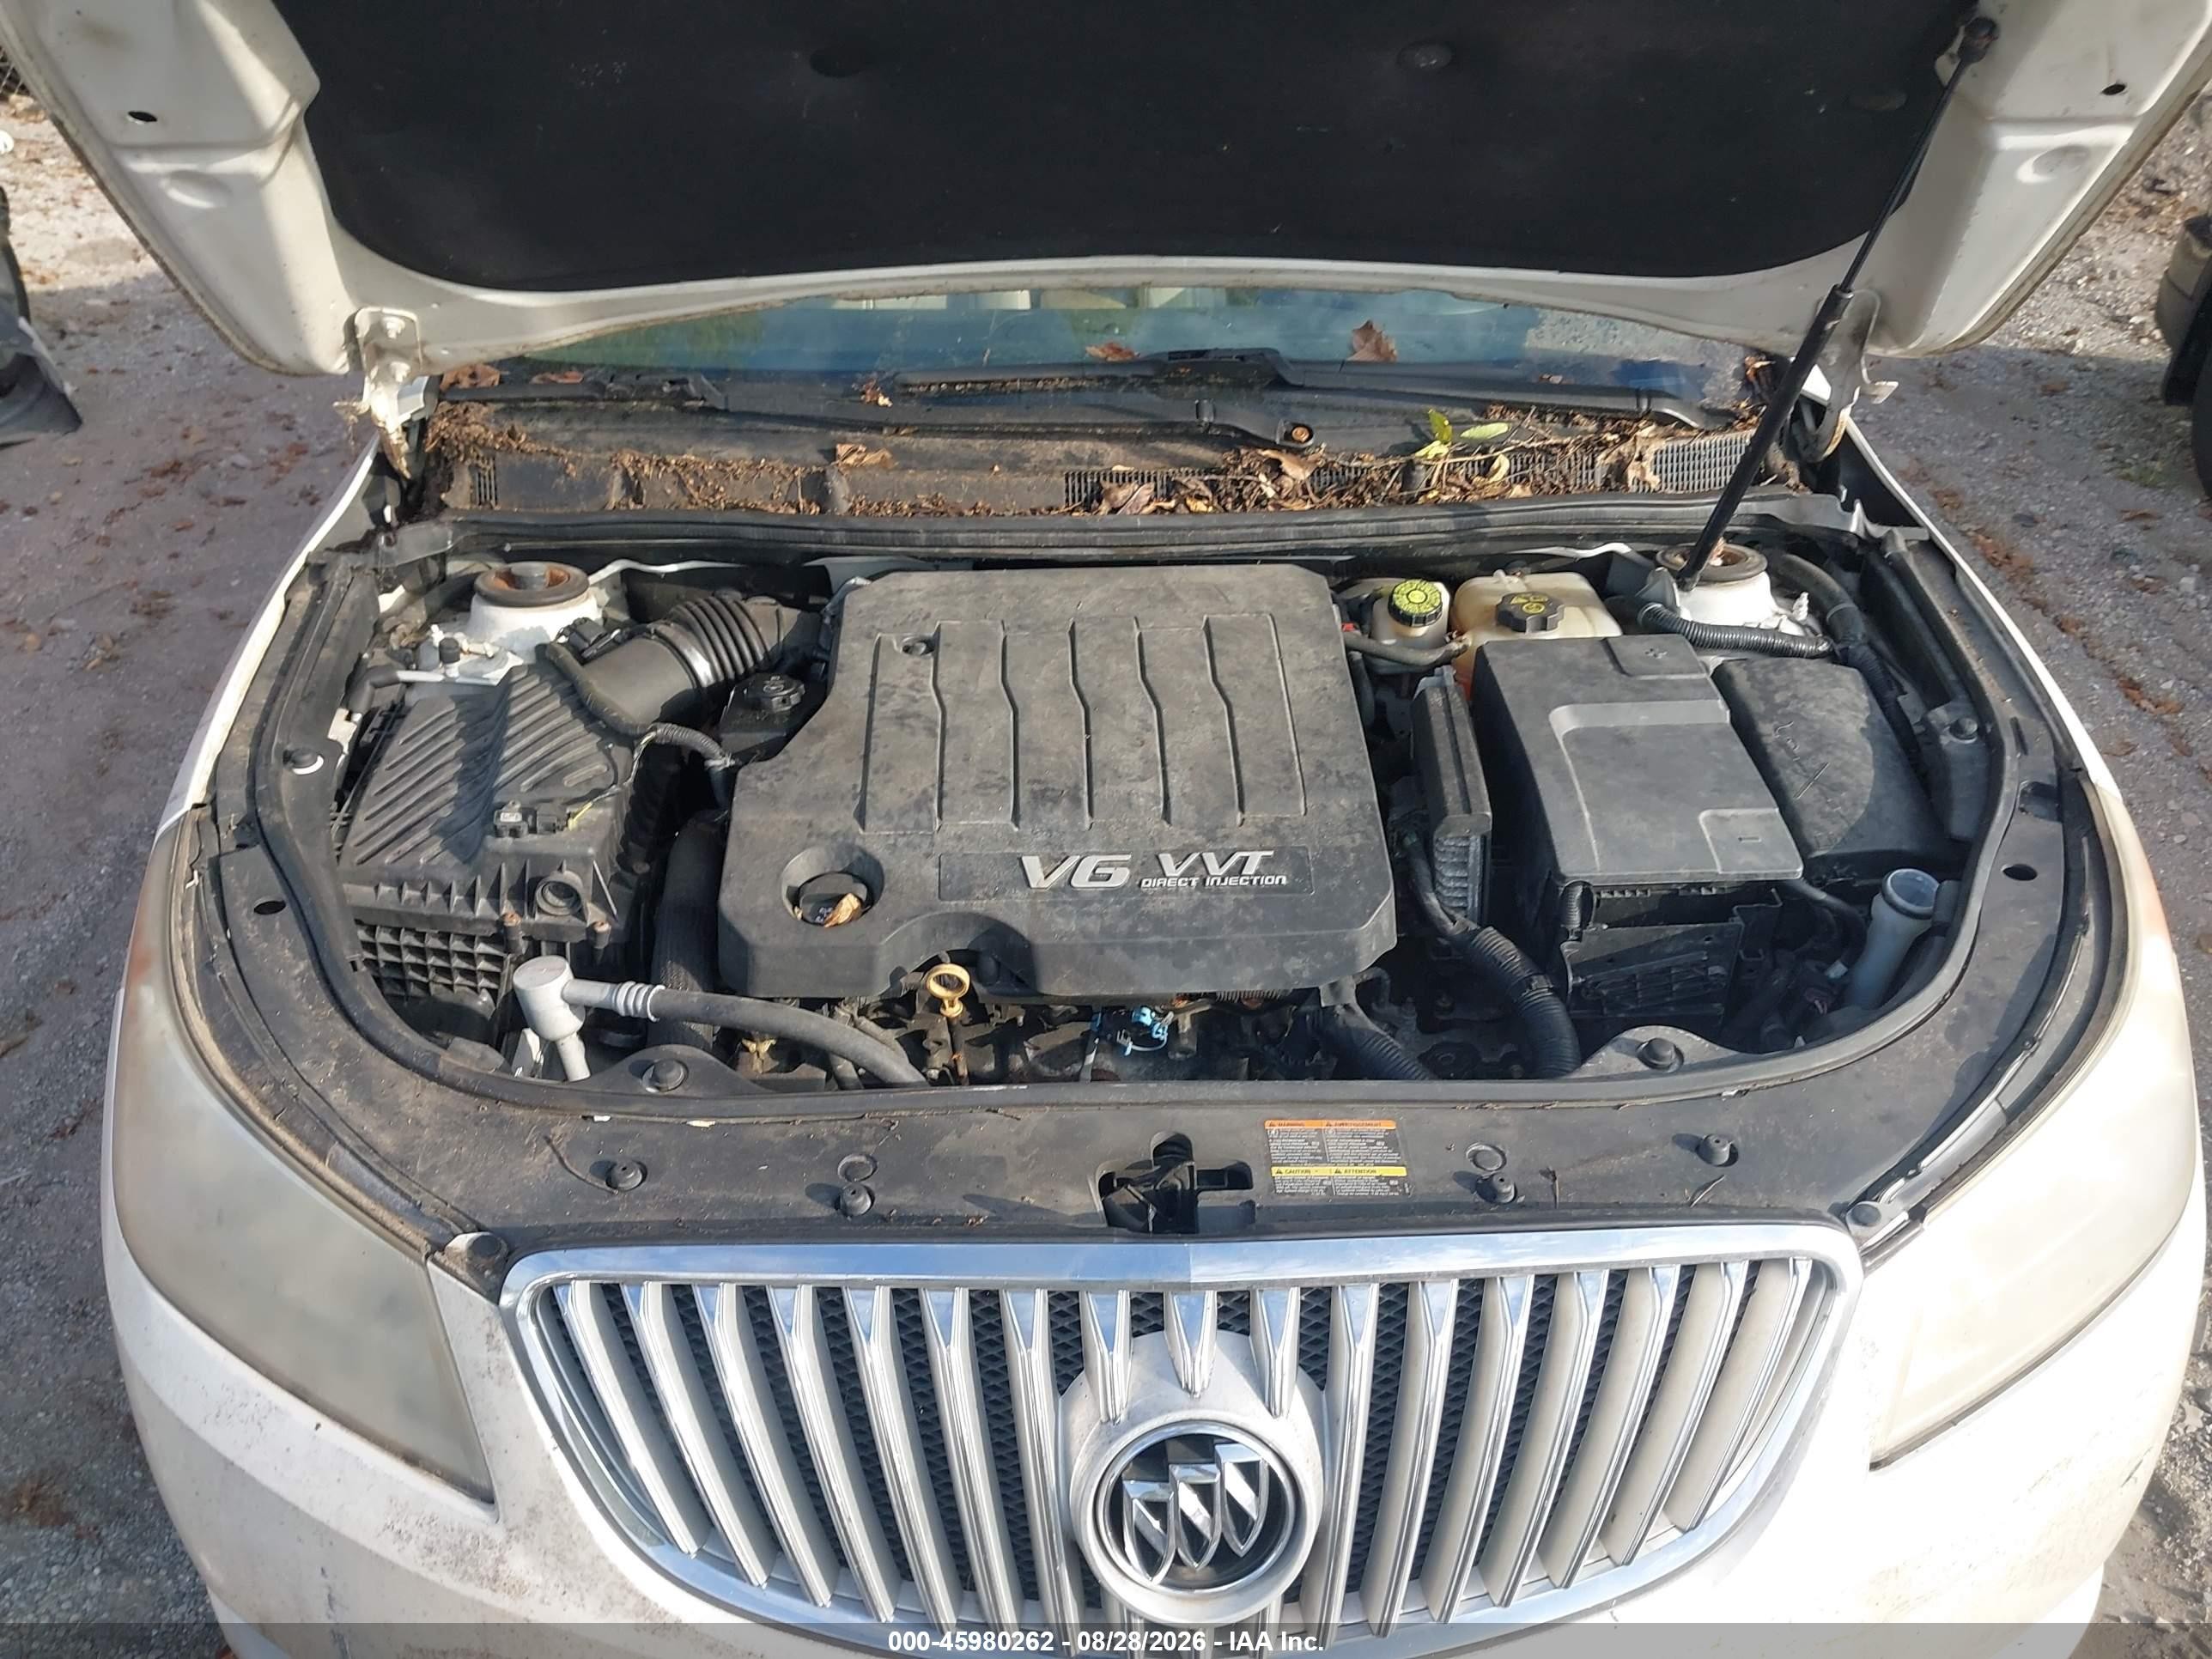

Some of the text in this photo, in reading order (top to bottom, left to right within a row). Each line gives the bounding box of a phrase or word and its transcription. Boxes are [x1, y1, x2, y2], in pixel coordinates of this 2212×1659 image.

[1021, 850, 1274, 889] V6 VVT
[1140, 875, 1287, 889] DIRECT INJECTION
